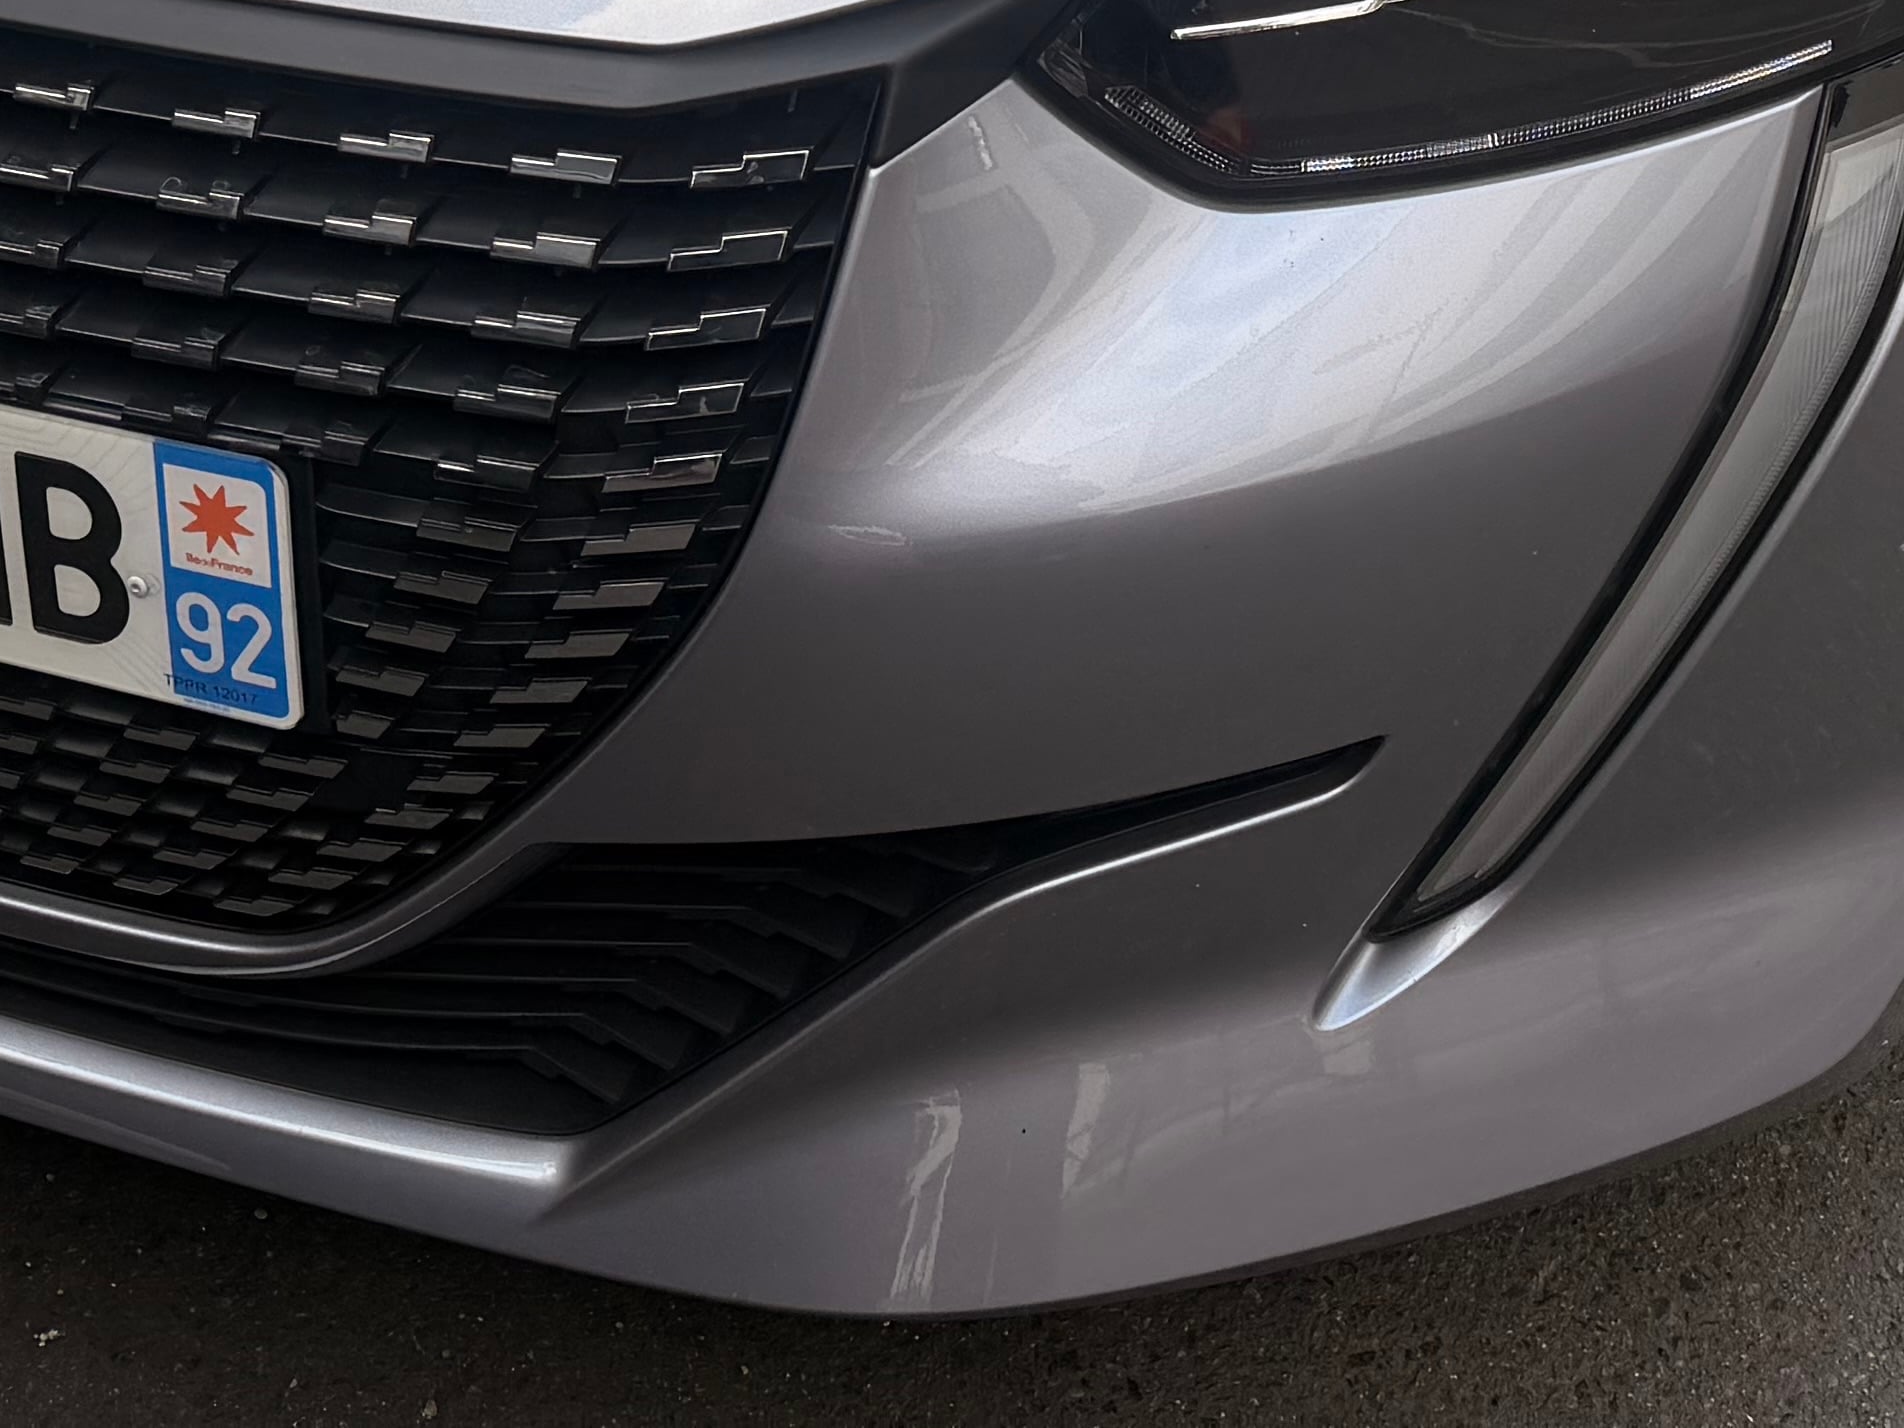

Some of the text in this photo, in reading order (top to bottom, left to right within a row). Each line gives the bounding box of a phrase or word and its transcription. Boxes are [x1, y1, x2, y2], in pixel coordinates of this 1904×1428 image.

[175, 591, 278, 689] 92
[163, 672, 258, 705] TPPR 12017
